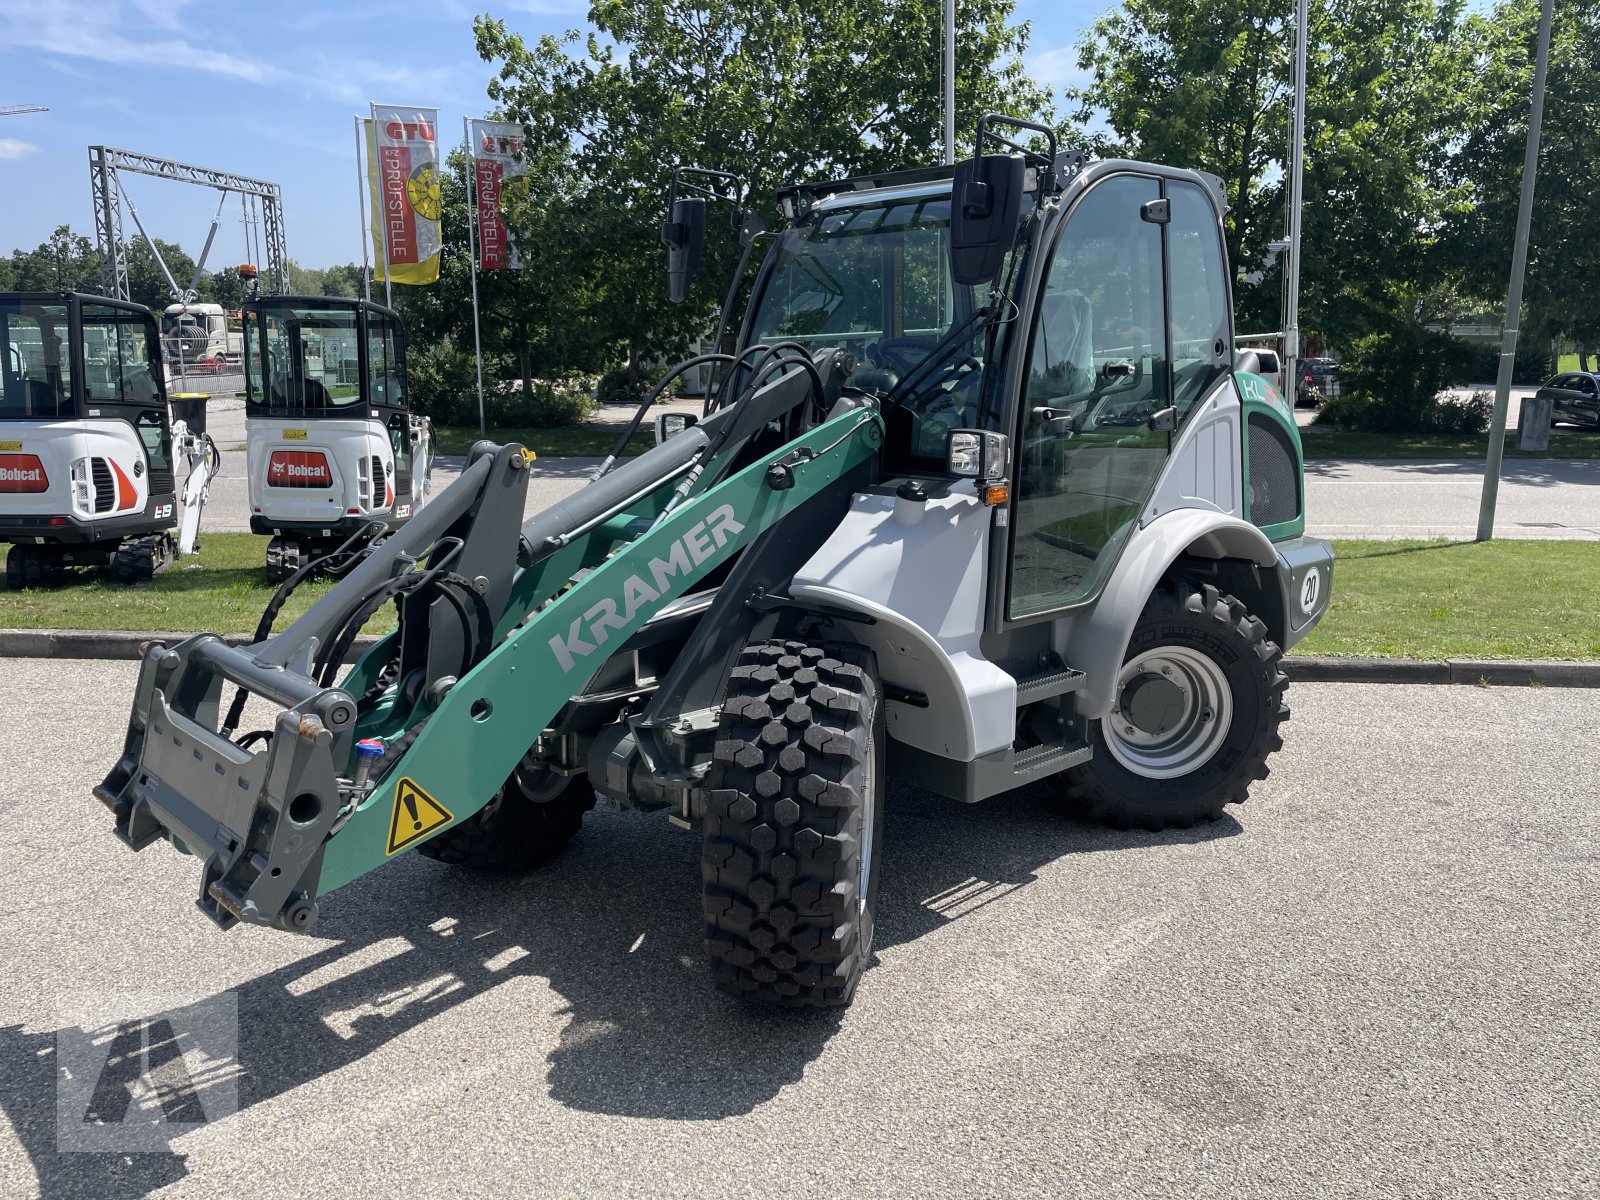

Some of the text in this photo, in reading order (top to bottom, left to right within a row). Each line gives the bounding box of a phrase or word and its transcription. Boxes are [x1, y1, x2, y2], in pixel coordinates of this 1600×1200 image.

[385, 149, 400, 157] KFZ
[386, 159, 407, 257] PRÜFSTELLE
[480, 170, 498, 262] PRÜFSTELLE
[0, 467, 40, 481] Bobcat
[287, 464, 325, 477] Bobcat
[154, 504, 173, 519] E19
[548, 503, 746, 674] KRAMER
[1304, 575, 1317, 606] 20
